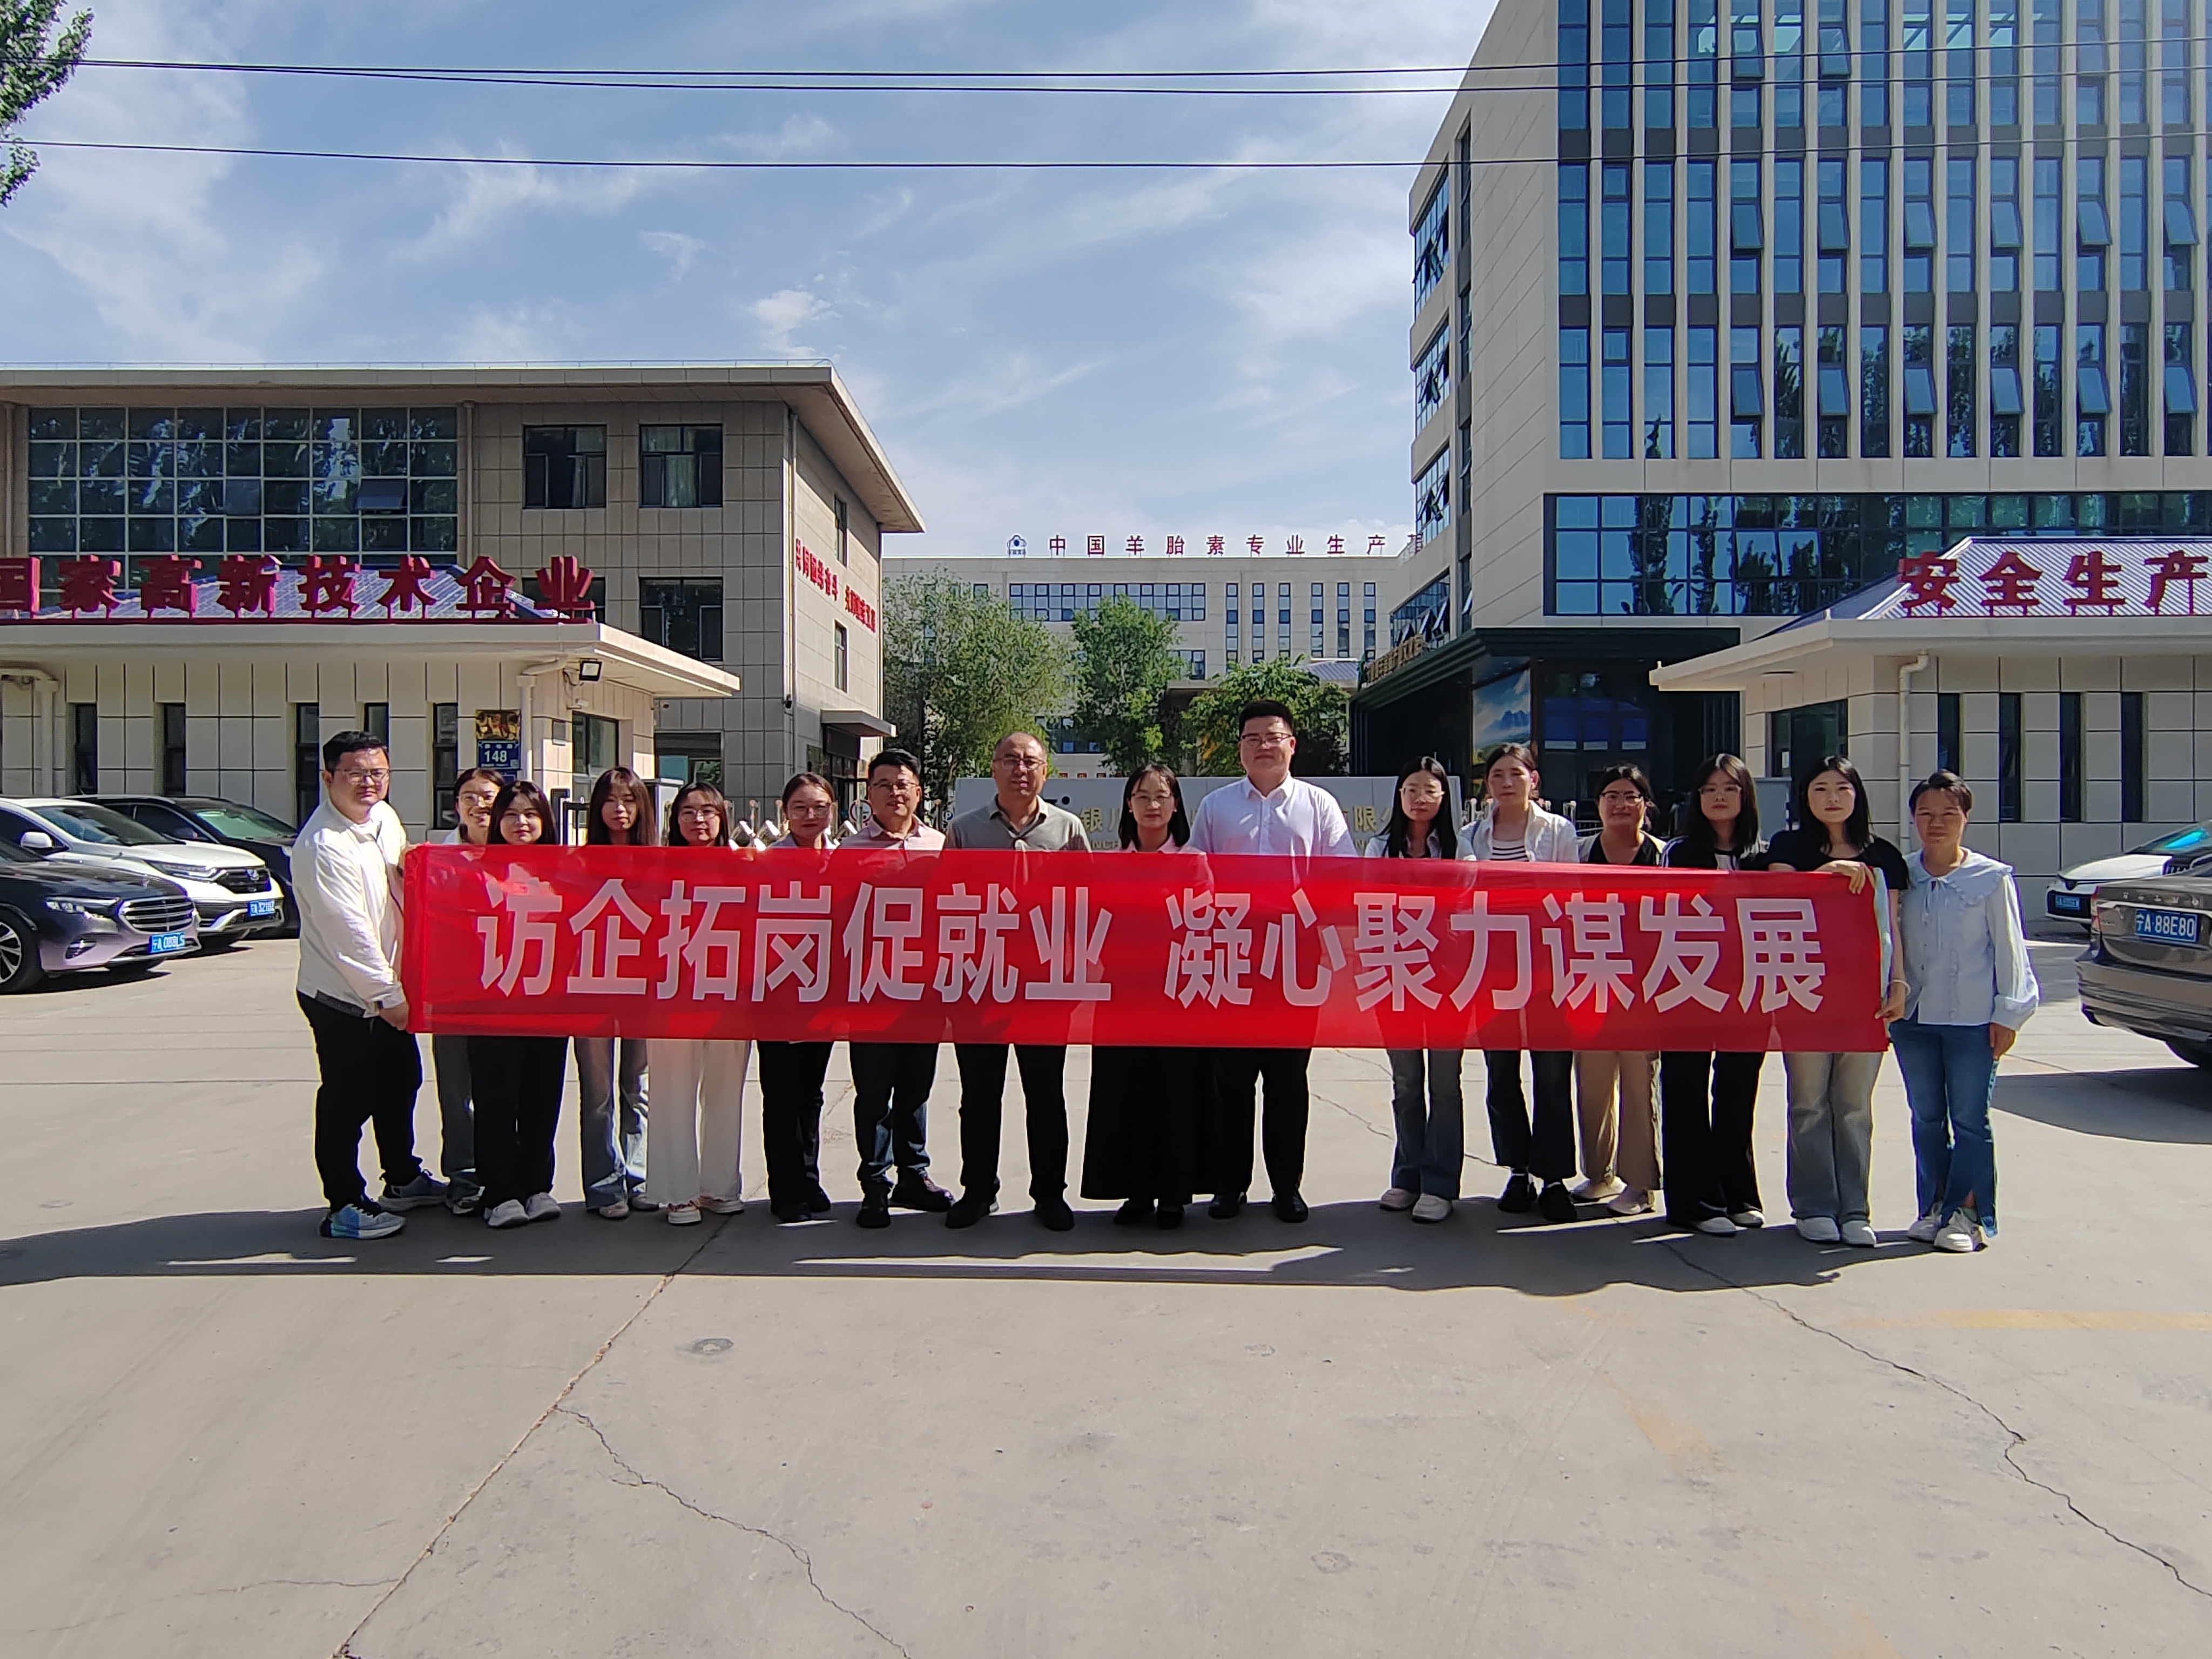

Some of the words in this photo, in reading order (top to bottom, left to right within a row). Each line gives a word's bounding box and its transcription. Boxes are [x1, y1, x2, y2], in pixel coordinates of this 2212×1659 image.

[0, 554, 595, 613] 国家高新技术企业
[1897, 550, 2210, 609] 安全生产
[484, 750, 507, 763] 148
[477, 879, 1112, 1003] 访企拓岗促就业
[1163, 887, 1827, 1014] 凝心聚力谋发展
